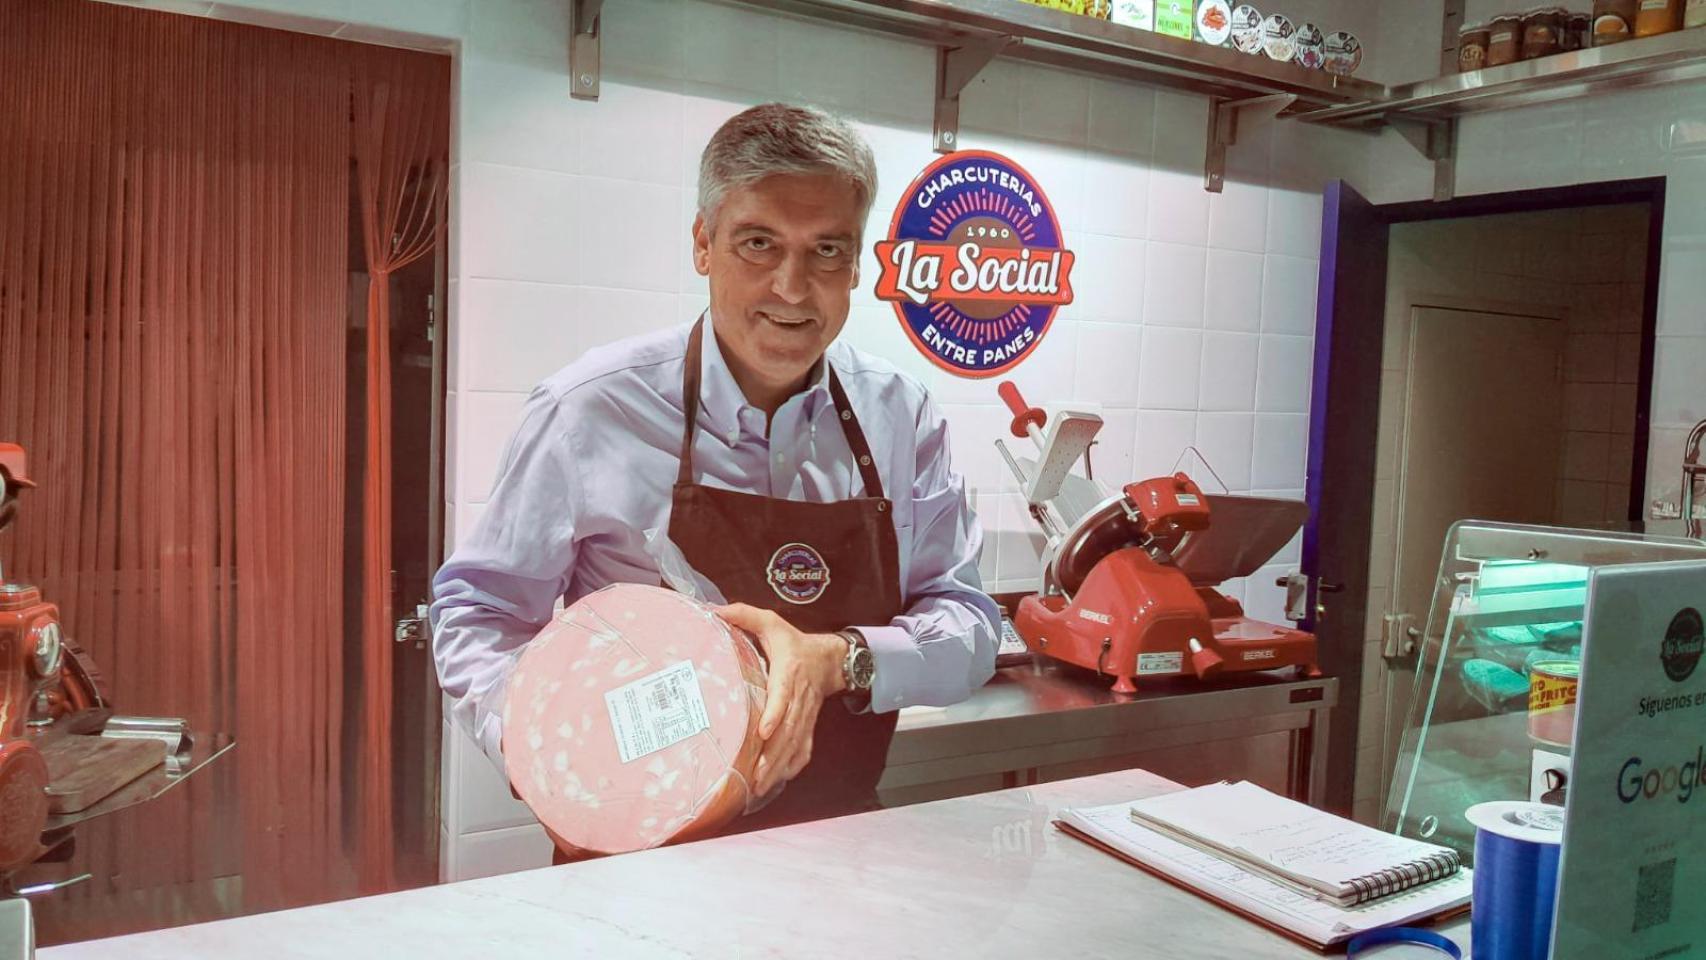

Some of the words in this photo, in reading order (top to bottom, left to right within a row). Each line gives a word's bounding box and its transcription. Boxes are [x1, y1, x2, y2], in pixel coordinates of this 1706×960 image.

[917, 166, 1042, 218] CHARCUTERIAS
[966, 226, 1010, 239] 1960
[891, 240, 941, 304] La
[951, 242, 1061, 294] Social
[921, 324, 977, 365] ENTRE
[983, 325, 1034, 365] PANES
[1638, 694, 1692, 718] Síguenos
